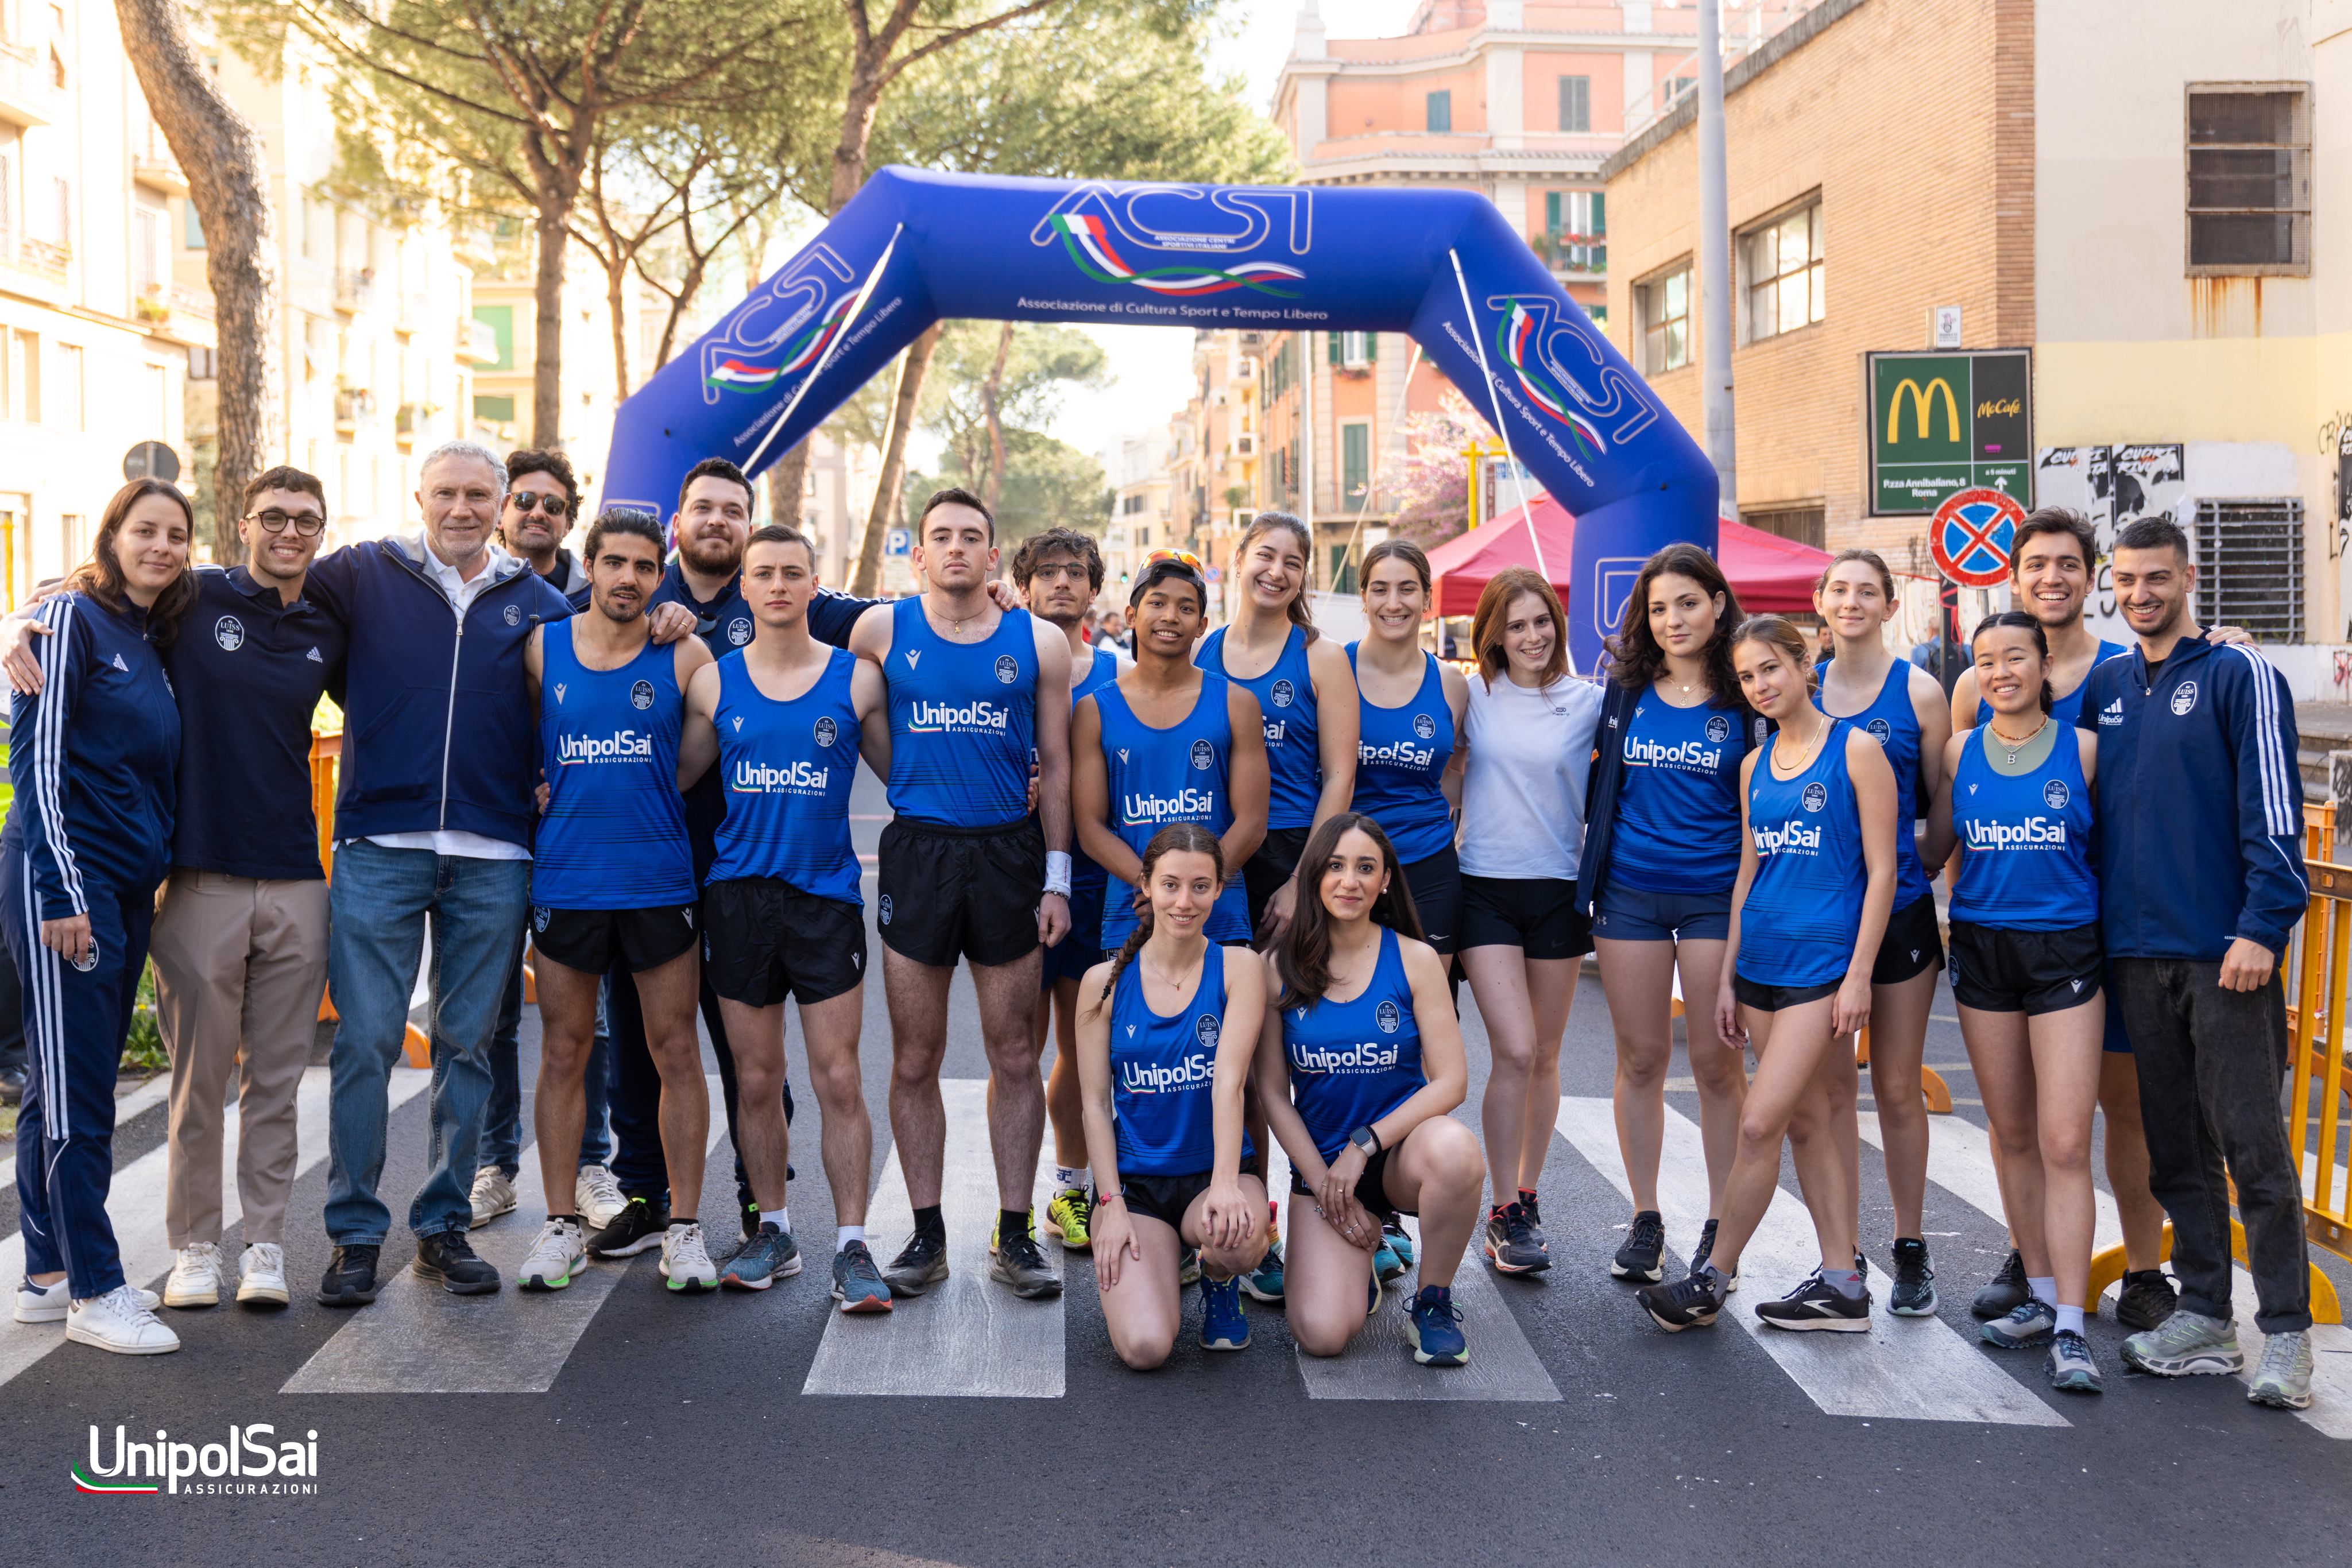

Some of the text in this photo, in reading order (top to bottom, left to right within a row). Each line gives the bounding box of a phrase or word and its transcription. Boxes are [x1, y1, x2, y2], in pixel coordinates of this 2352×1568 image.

[1154, 235, 1207, 243] ASSOCIAZIONE
[873, 296, 903, 323] Libero
[1017, 296, 1329, 320] Associazione di Cultura Sport e Tempo Libero
[846, 320, 877, 347] Tempo
[842, 342, 851, 351] e
[733, 401, 785, 447] Associazione
[1494, 377, 1522, 409] Cultura
[1520, 405, 1544, 431] Sport
[1539, 428, 1548, 438] e
[1545, 432, 1572, 463] Tempo
[1569, 459, 1595, 487] Libero
[1995, 467, 2017, 475] minuti
[1905, 477, 1959, 488] Annibaliano,
[1959, 477, 1966, 487] 8
[1912, 488, 1938, 497] Roma
[220, 621, 240, 631] LUISS
[307, 653, 323, 663] adidas
[913, 701, 1009, 731] UnipolSai
[2098, 713, 2123, 725] UnipolSai
[953, 726, 1006, 736] ASSICURAZIONI
[560, 730, 652, 763] UnipolSai
[1624, 736, 1722, 768] UnipolSai
[1370, 760, 1429, 771] ASSICURAZIONI
[1659, 762, 1718, 775] ASSICURAZIONI
[737, 761, 829, 792] UnipolSai
[772, 787, 826, 796] ASSICURAZIONI
[1125, 789, 1213, 823] UnipolSai
[1966, 817, 2065, 850] UnipolSai
[1293, 1043, 1398, 1074] UnipolSai
[1336, 1066, 1395, 1074] ASSICURAZIONI
